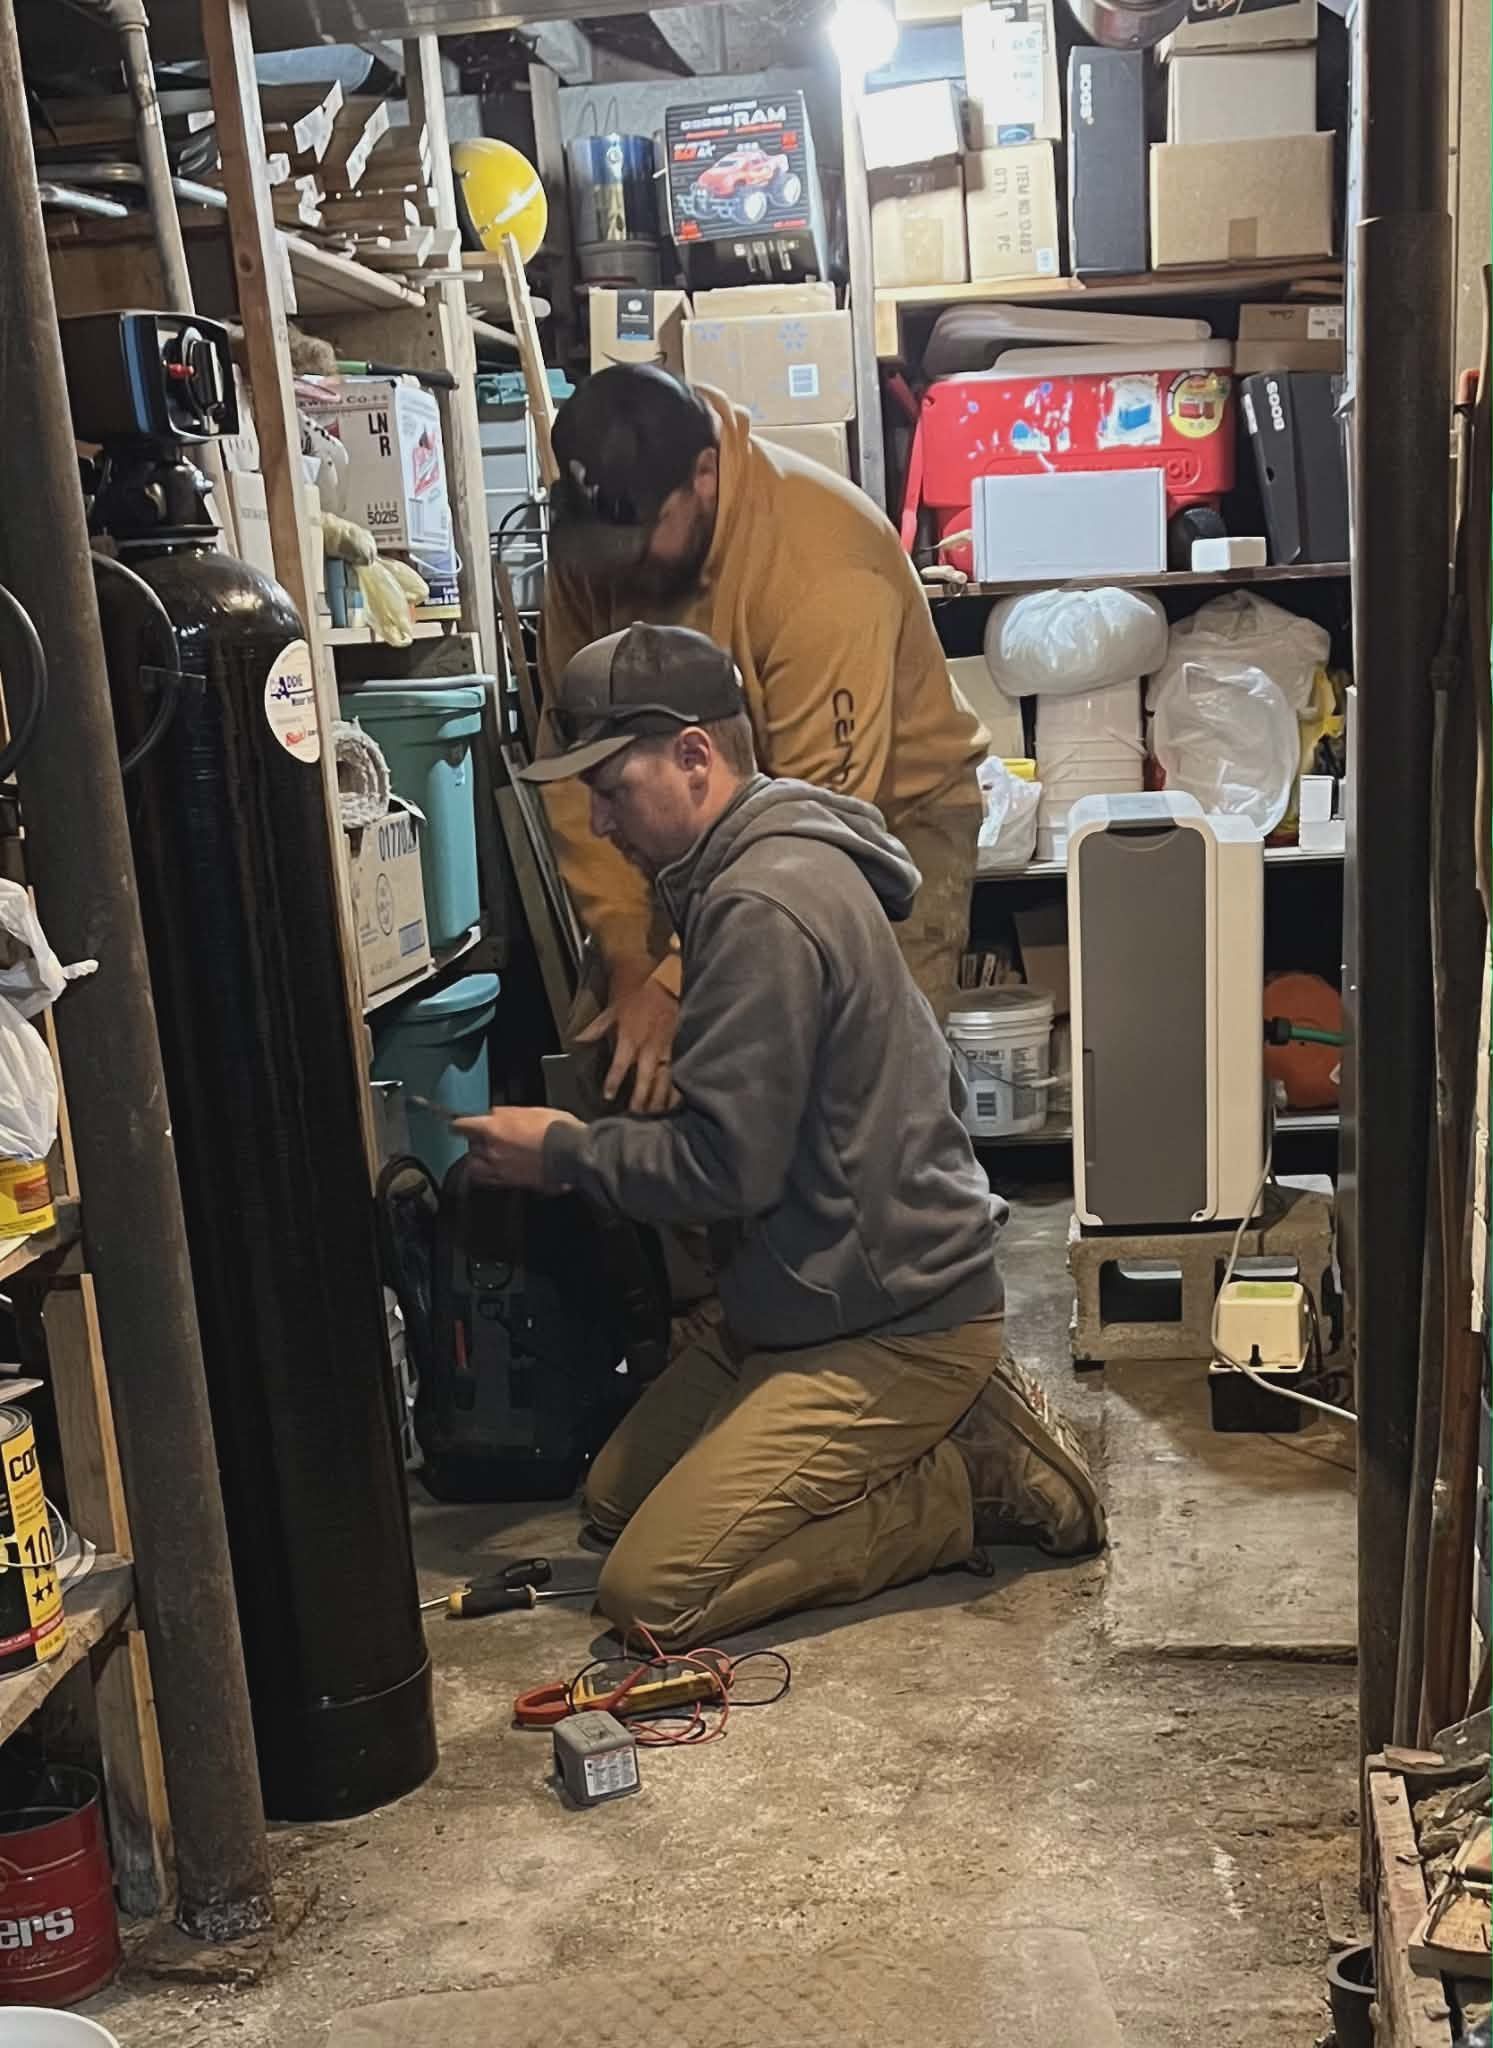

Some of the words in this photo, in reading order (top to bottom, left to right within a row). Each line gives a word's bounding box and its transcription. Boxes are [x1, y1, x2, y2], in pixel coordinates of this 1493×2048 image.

[733, 105, 786, 128] RAM
[368, 411, 388, 435] LN
[379, 435, 391, 457] R
[367, 508, 400, 526] 50215
[9, 1443, 37, 1482] CO
[24, 1526, 54, 1579] 10
